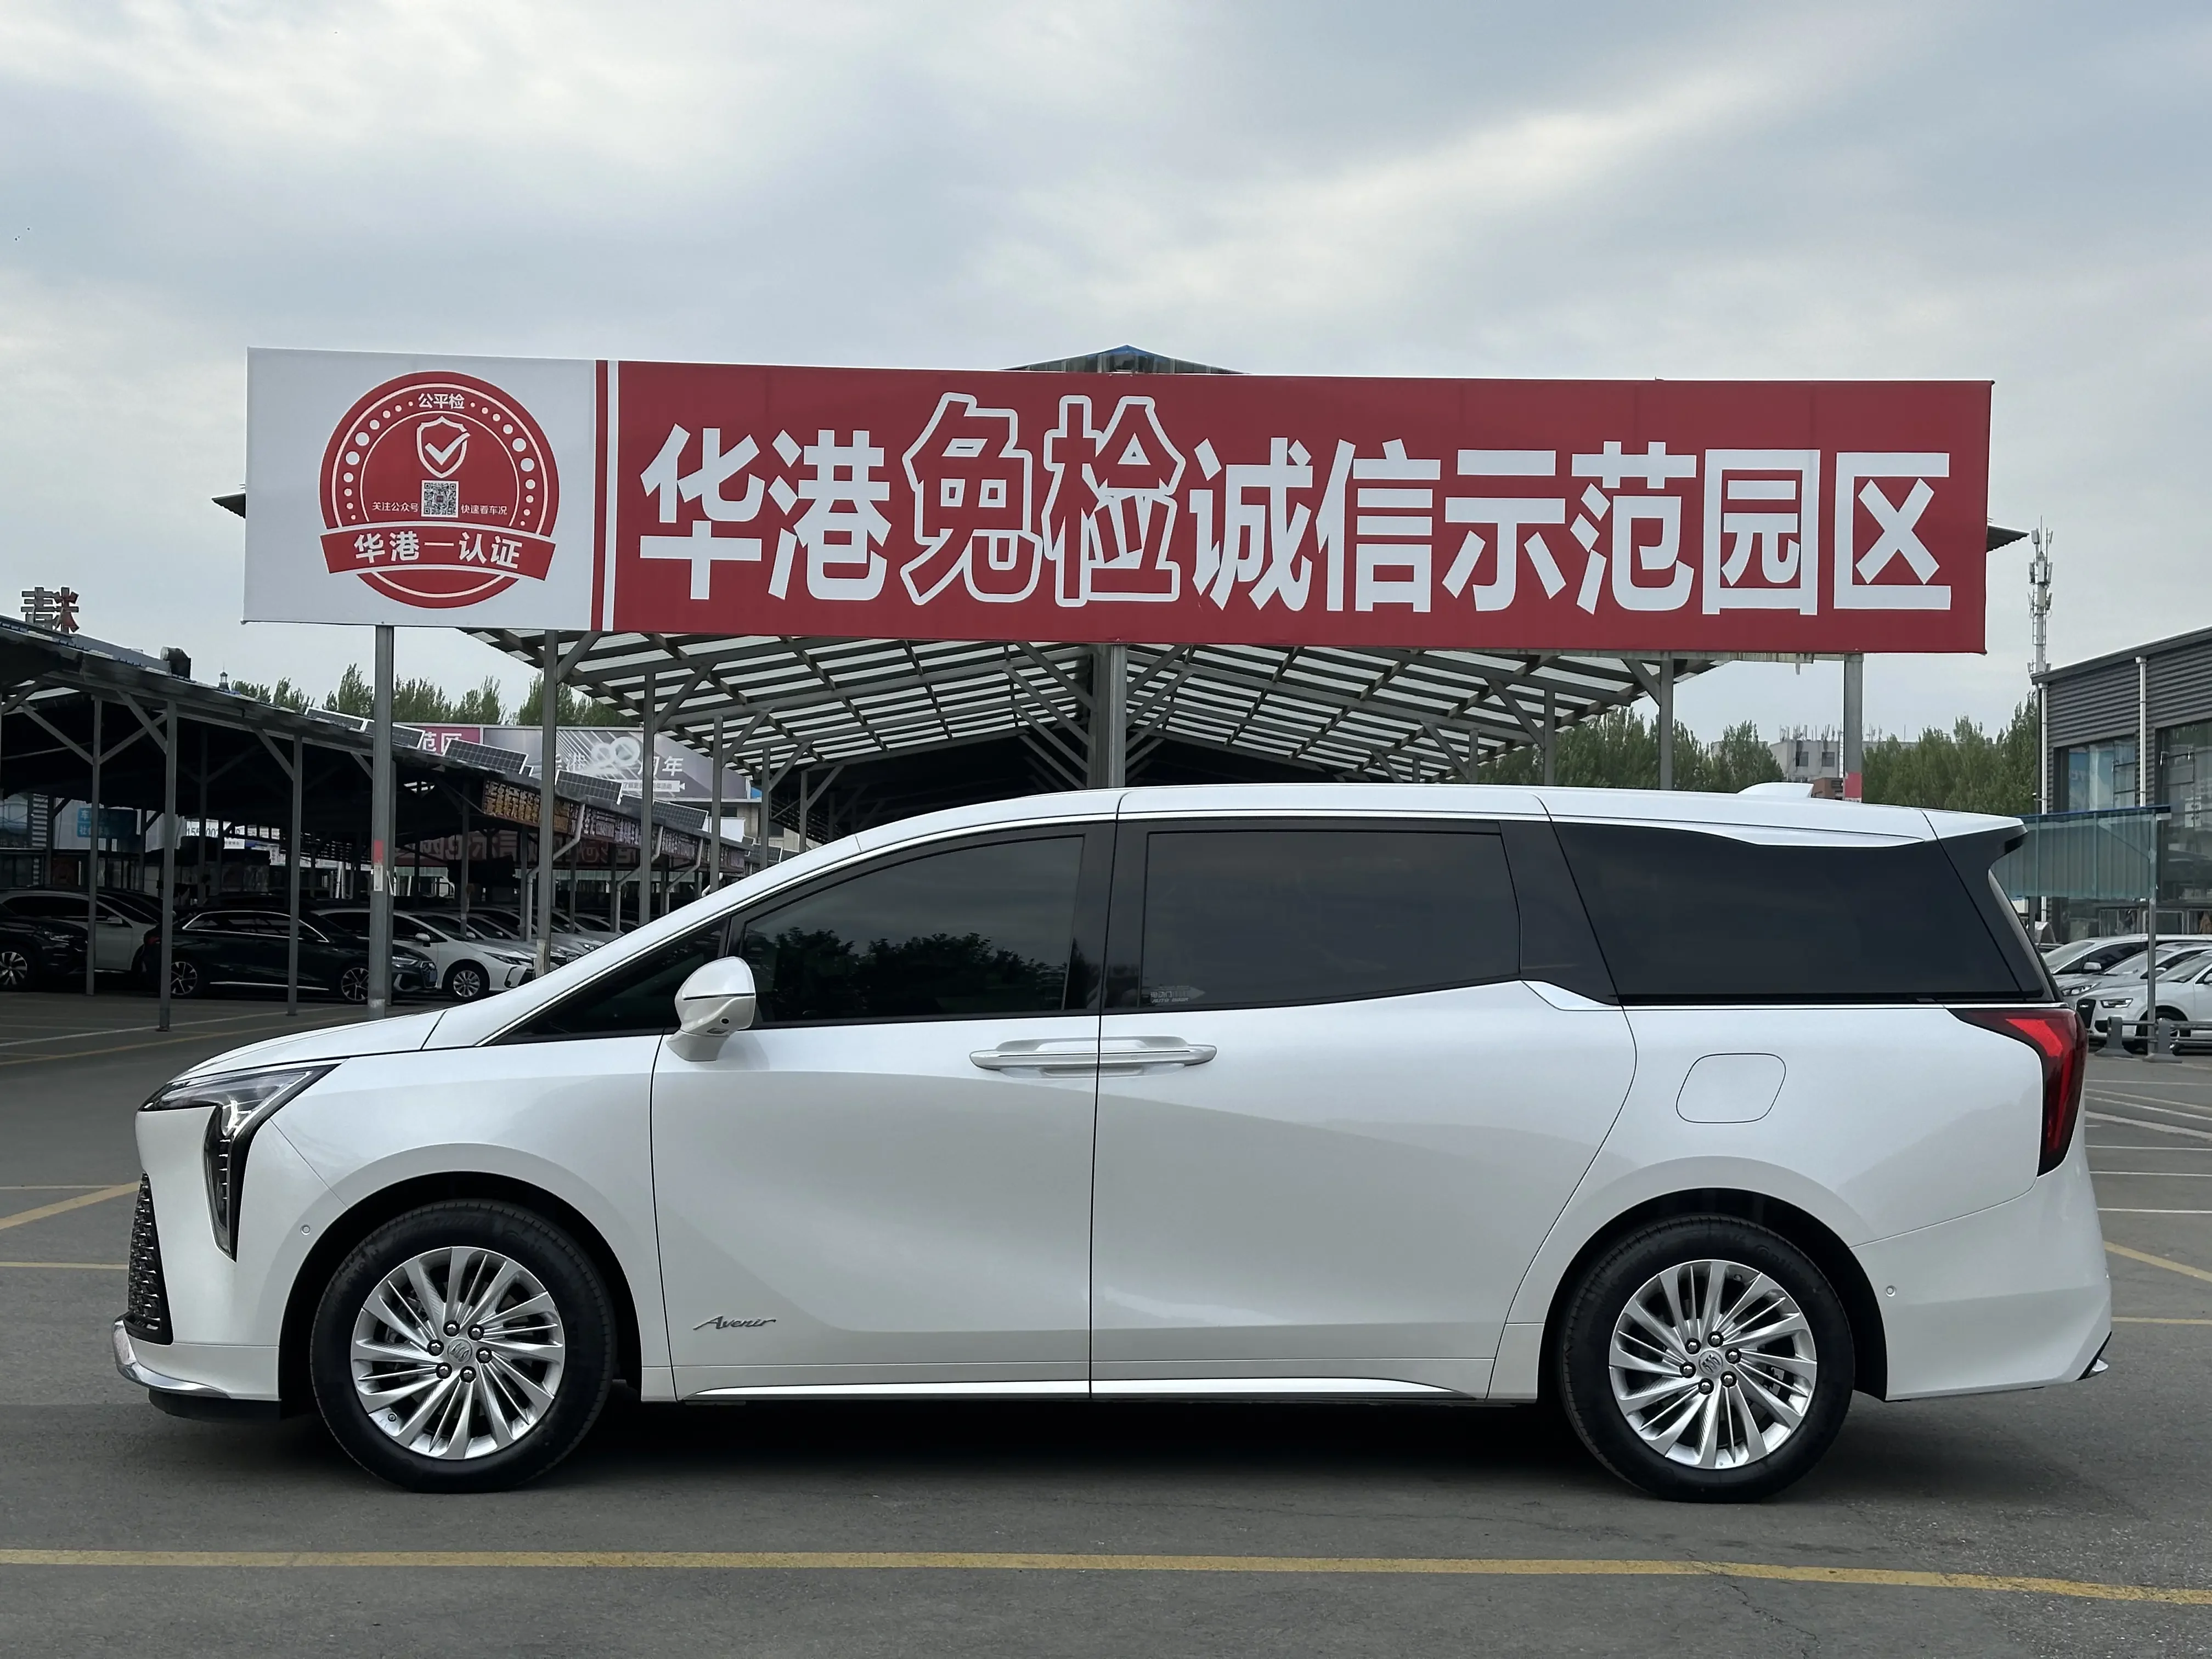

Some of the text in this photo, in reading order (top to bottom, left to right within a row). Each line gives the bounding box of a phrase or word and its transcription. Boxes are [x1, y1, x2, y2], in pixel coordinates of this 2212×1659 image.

[418, 392, 465, 410] 公平检
[373, 501, 419, 512] 关注公众号
[461, 504, 507, 515] 快速看车况
[640, 392, 1951, 615] 华港免检诚信示范园区
[693, 1316, 776, 1330] Avenir
